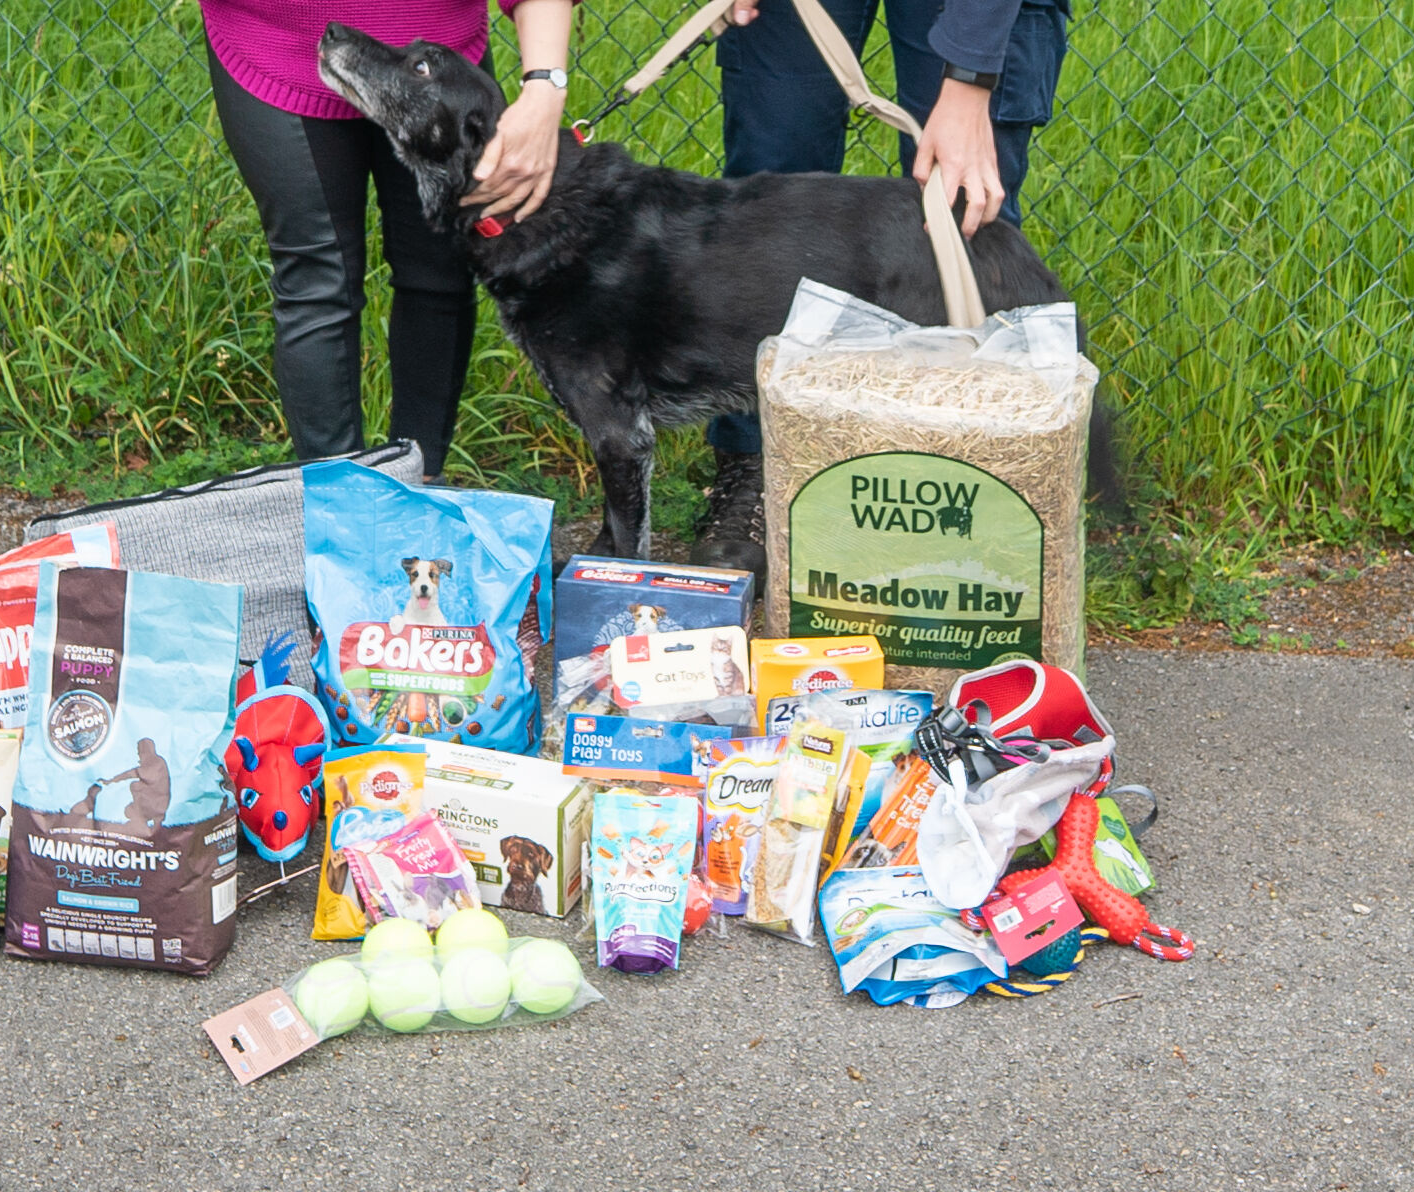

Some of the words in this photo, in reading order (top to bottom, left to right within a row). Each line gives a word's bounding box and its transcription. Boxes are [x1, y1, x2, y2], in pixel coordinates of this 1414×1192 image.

[851, 475, 980, 508] PILLOW
[850, 503, 936, 534] WAD
[581, 569, 638, 583] Bakers
[807, 569, 950, 611] Meadow
[958, 583, 1024, 618] Hay
[433, 630, 474, 640] PURINA
[810, 611, 897, 636] Superior
[899, 623, 976, 648] quality
[973, 625, 1022, 649] feed
[64, 645, 115, 658] COMPLETE
[356, 625, 484, 674] Bakers
[883, 646, 913, 658] ature
[916, 646, 972, 662] intended
[60, 661, 114, 677] PUPPY
[70, 654, 114, 665] BALANCED
[386, 673, 465, 692] SUPERFOODS
[655, 672, 676, 683] Cat
[680, 669, 707, 682] Toys
[791, 677, 854, 692] Pedigree
[54, 713, 105, 739] SALMON
[360, 779, 414, 795] Pedigree
[437, 808, 499, 829] RINGTONS
[27, 834, 181, 872] WAINWRIGHT'S
[394, 838, 431, 858] Fruity
[402, 846, 438, 866] Treat
[416, 858, 440, 873] Mix
[55, 865, 81, 889] Dog's
[79, 869, 109, 886] Best
[108, 872, 143, 888] Friend
